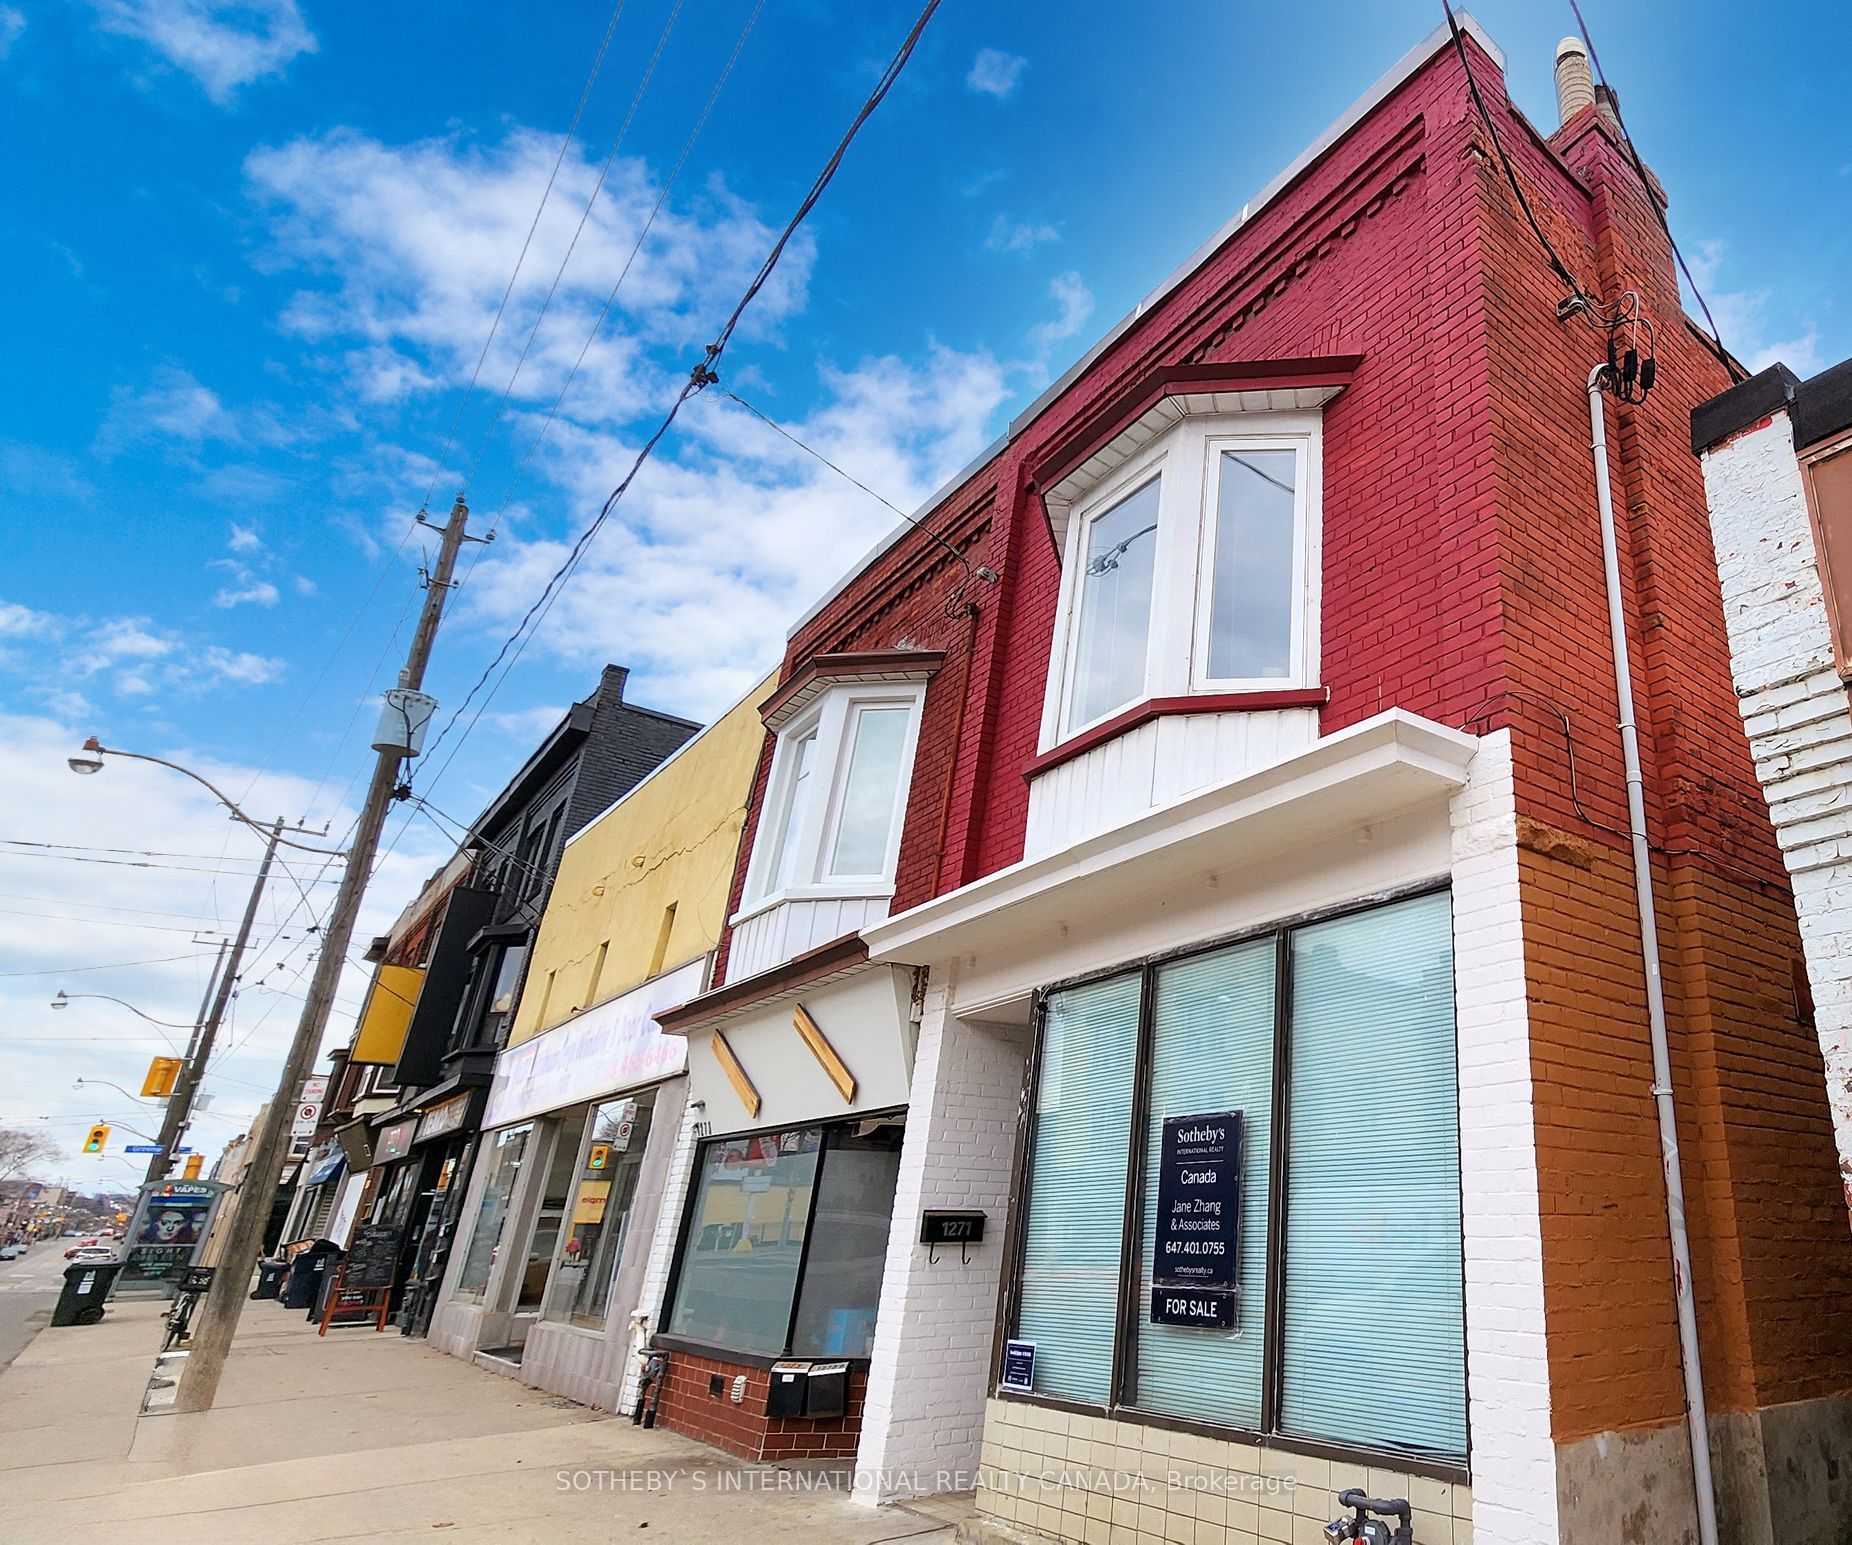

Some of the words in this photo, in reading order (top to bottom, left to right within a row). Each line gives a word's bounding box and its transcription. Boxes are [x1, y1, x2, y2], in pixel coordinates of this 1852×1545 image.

[1177, 1125, 1225, 1144] Sotheby's
[1177, 1147, 1208, 1155] INTERNATIONAL
[1181, 1169, 1216, 1184] Canada
[1171, 1199, 1191, 1213] Jane
[1193, 1199, 1221, 1215] Zhang
[942, 1221, 972, 1237] 1271
[1170, 1218, 1177, 1231] &
[1178, 1218, 1220, 1231] Associates
[1165, 1241, 1225, 1255] 647.401.0755
[1165, 1298, 1187, 1315] FOR
[1189, 1300, 1218, 1318] SALE
